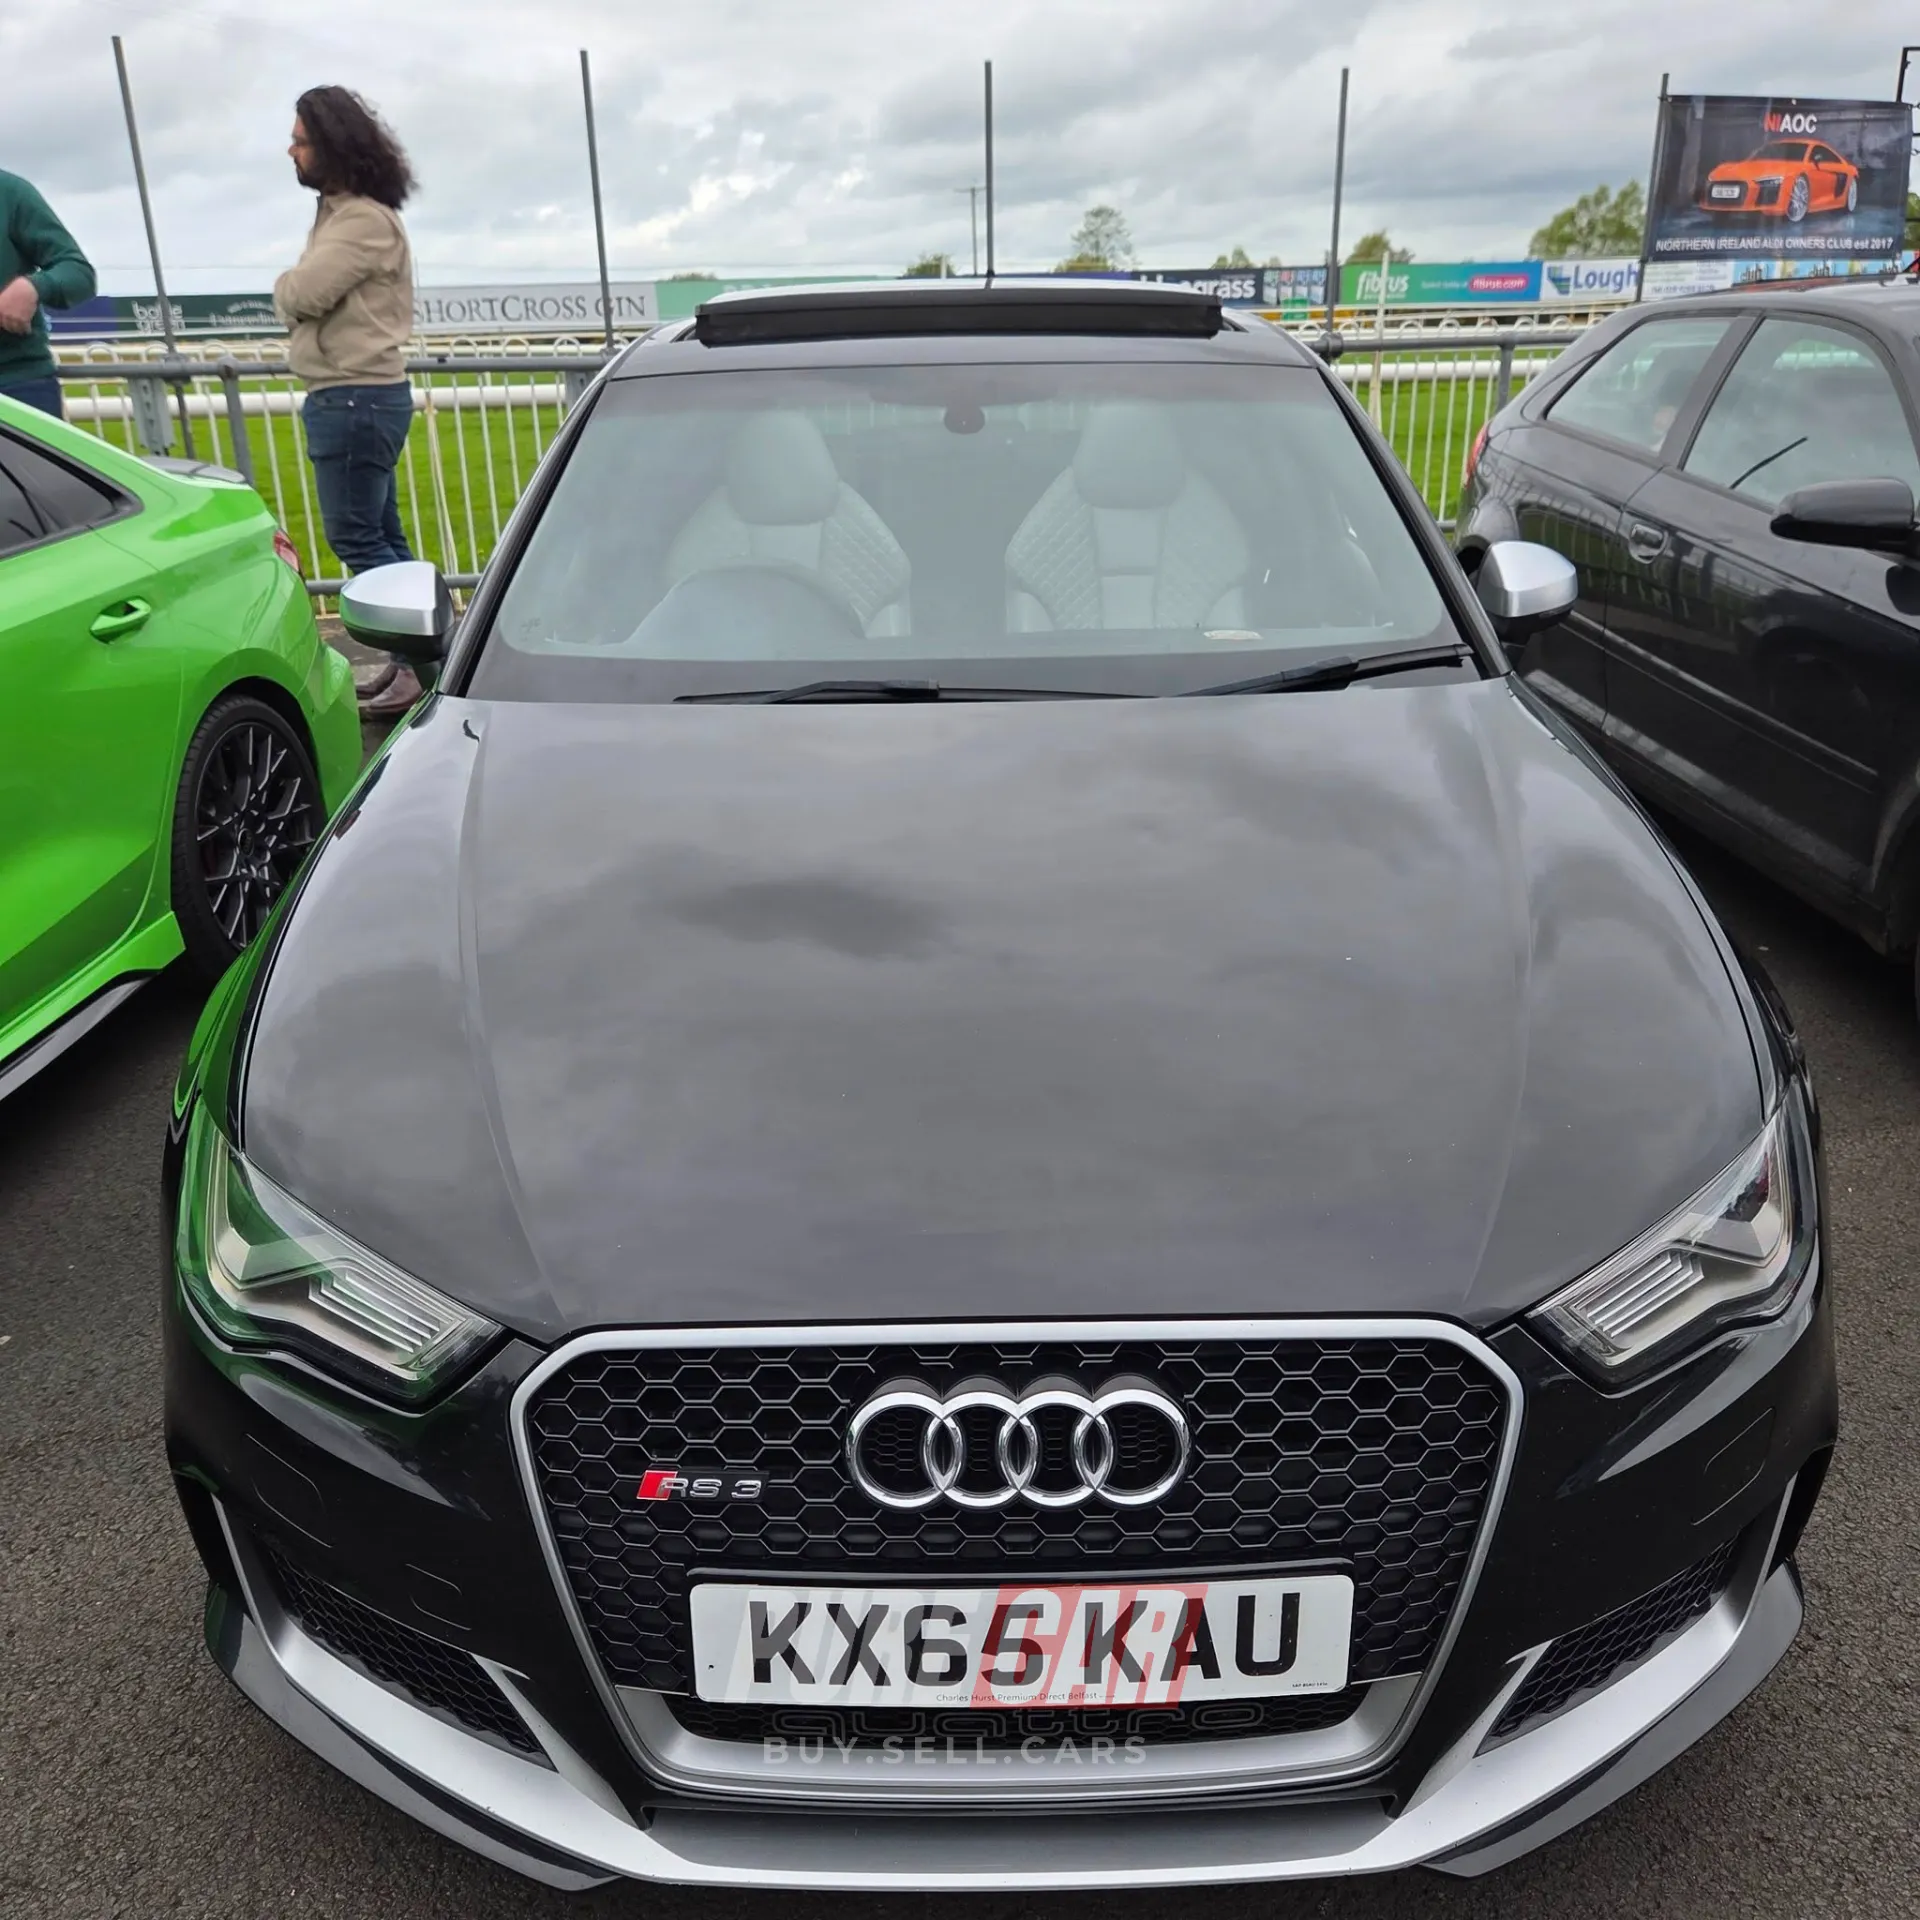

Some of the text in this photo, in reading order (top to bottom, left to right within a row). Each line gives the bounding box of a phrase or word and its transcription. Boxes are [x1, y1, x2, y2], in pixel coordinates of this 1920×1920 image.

[1764, 112, 1818, 133] NIAOC
[1656, 237, 1715, 251] NORTHERN
[1717, 236, 1760, 250] IRELAND
[1573, 264, 1639, 293] Lough
[656, 1477, 762, 1499] RS 3
[748, 1592, 1301, 1687] KX65 KAU
[936, 1691, 1098, 1702] Charles Hurst Premium Direct Belfast
